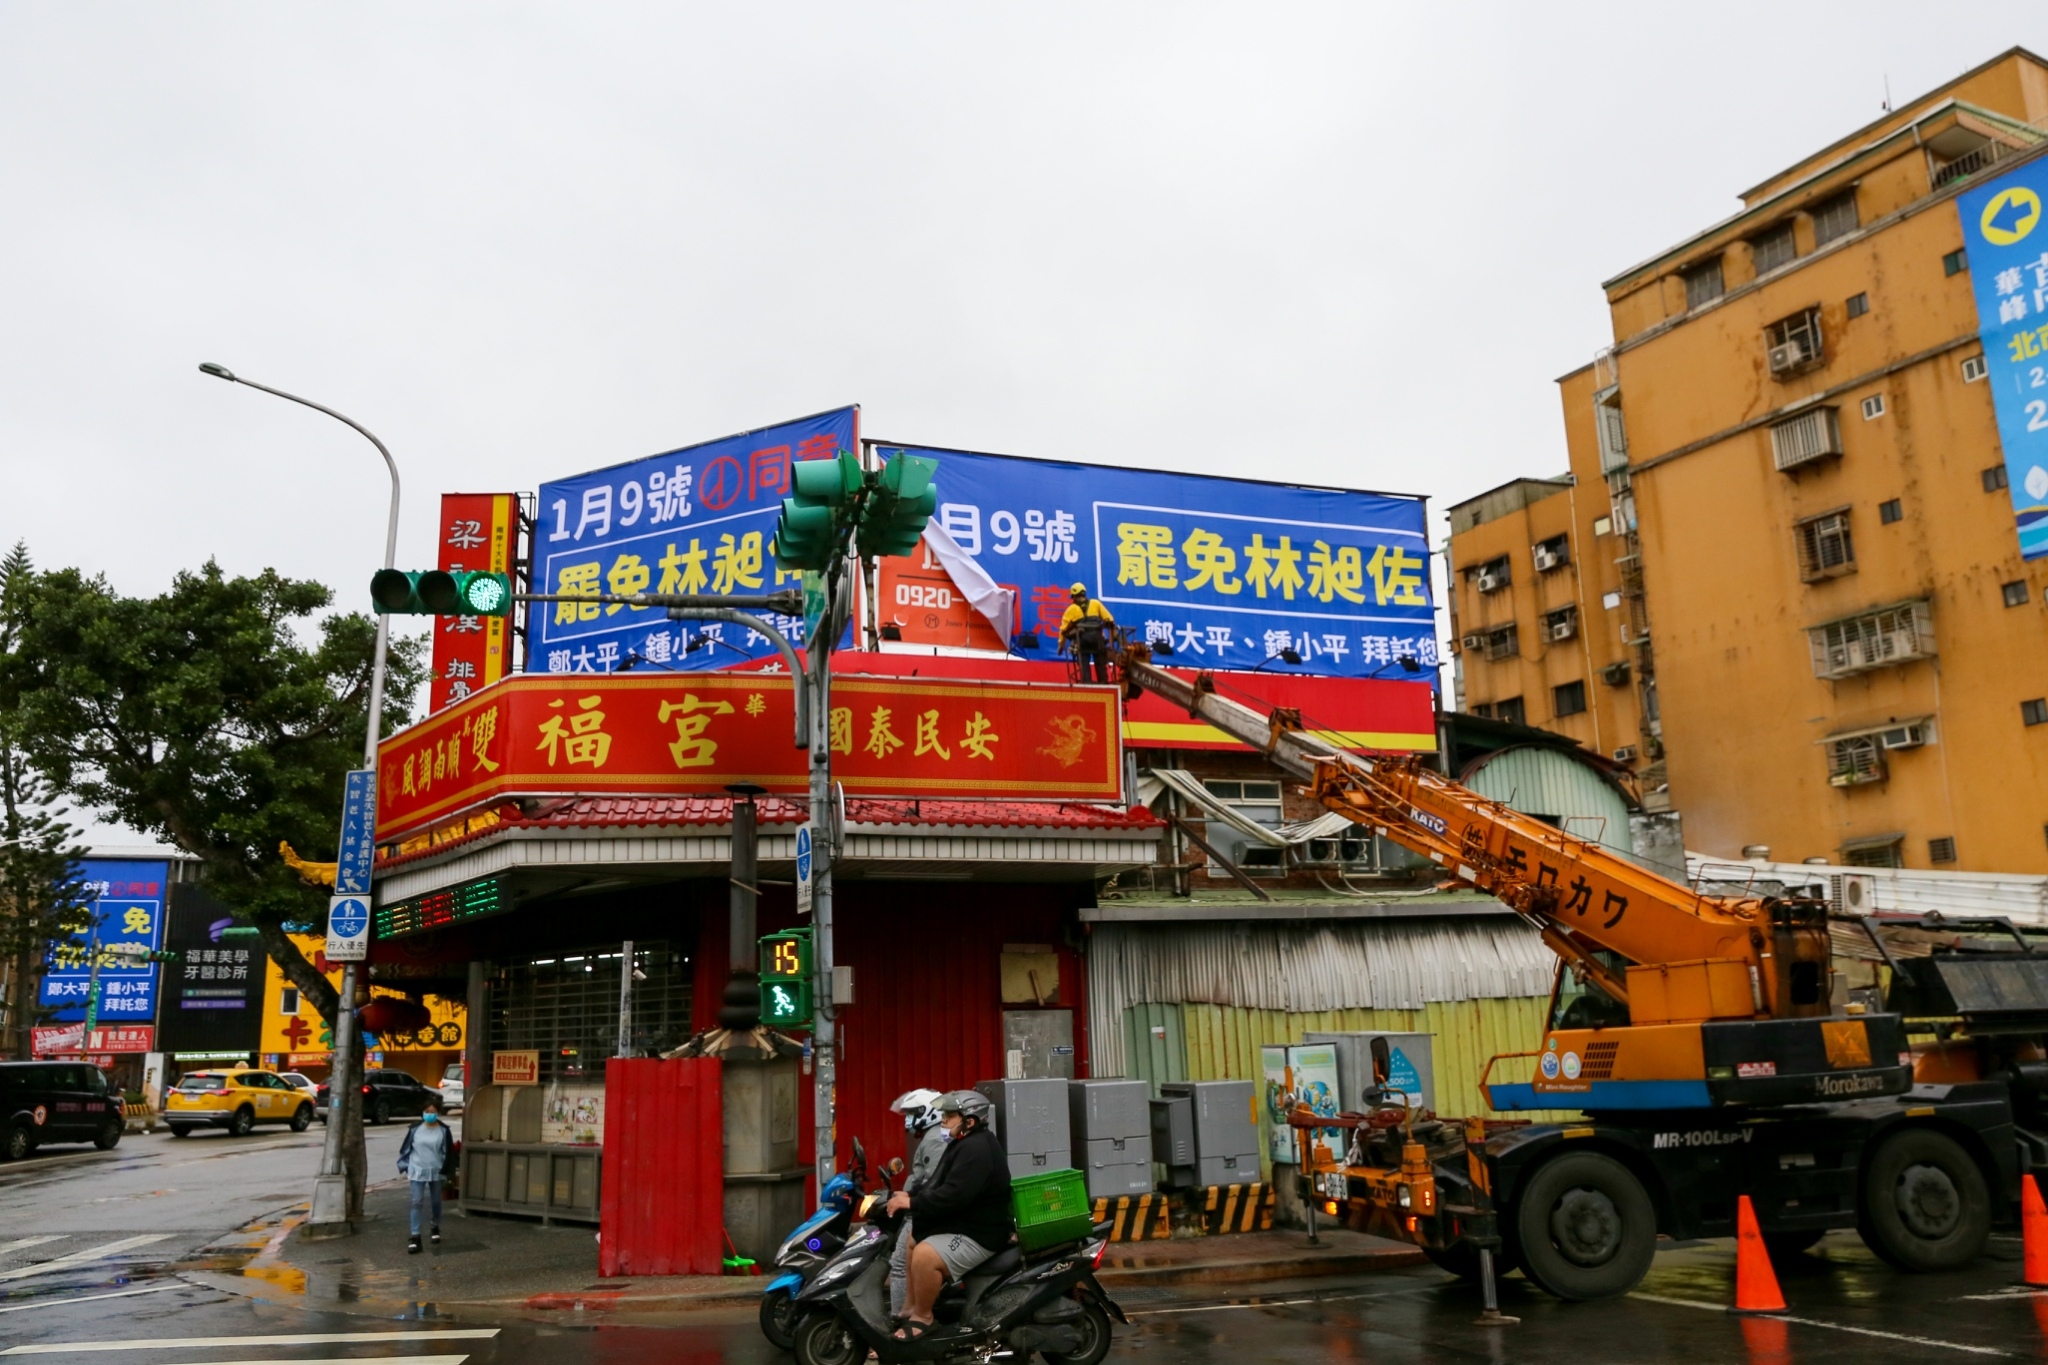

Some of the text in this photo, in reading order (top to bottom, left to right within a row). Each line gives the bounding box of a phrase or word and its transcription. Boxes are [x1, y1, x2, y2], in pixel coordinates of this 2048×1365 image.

[550, 465, 692, 542] 1月9號
[1117, 522, 1427, 606] 罷免林昶佐
[1363, 633, 1438, 667] 拜託您
[1410, 808, 1447, 833] KATO
[185, 949, 250, 964] 福華美學
[327, 939, 366, 952] 行人優先
[775, 941, 799, 975] 15
[184, 965, 249, 980] 牙醫診所
